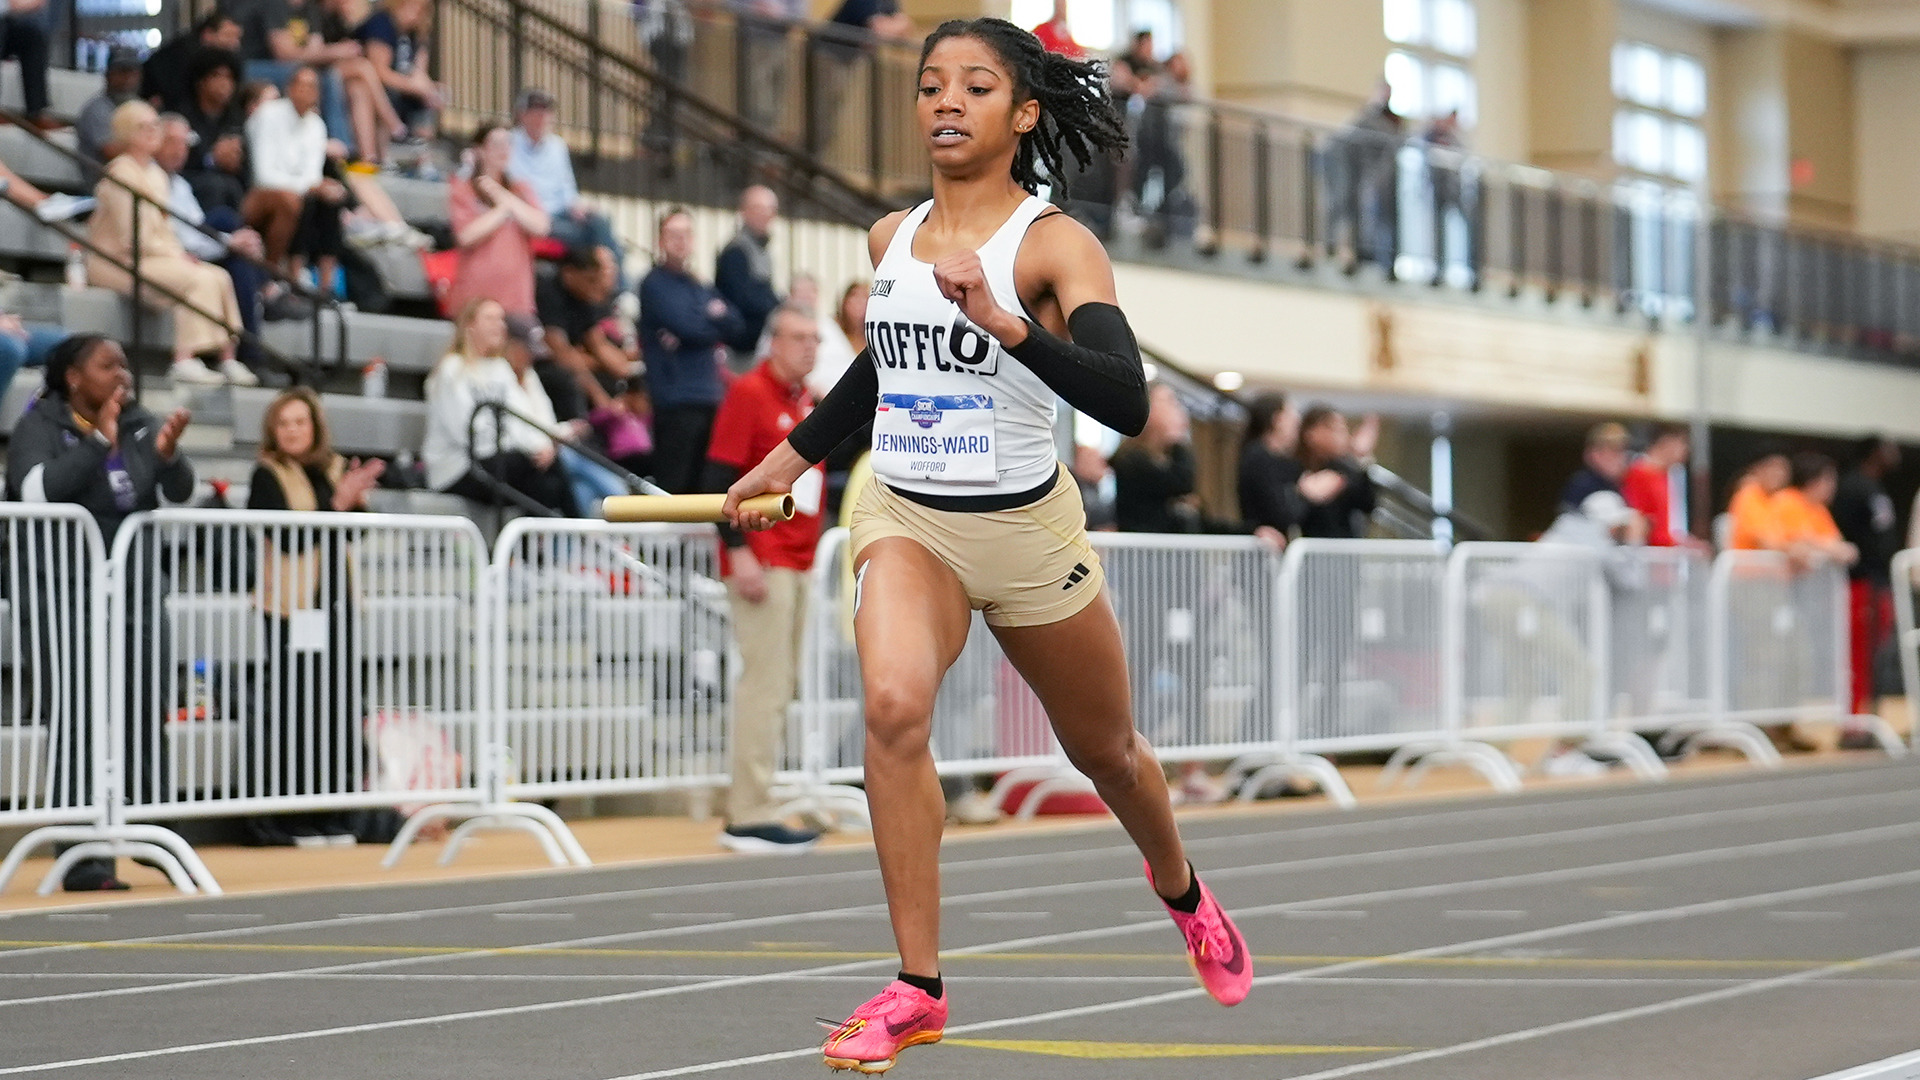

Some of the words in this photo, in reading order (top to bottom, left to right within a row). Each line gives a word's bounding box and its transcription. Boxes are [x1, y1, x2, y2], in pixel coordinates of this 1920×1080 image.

[866, 321, 998, 377] OFFO
[949, 309, 990, 365] 6
[875, 433, 989, 455] JENNINGS-WARD
[910, 460, 947, 473] WOFFORD
